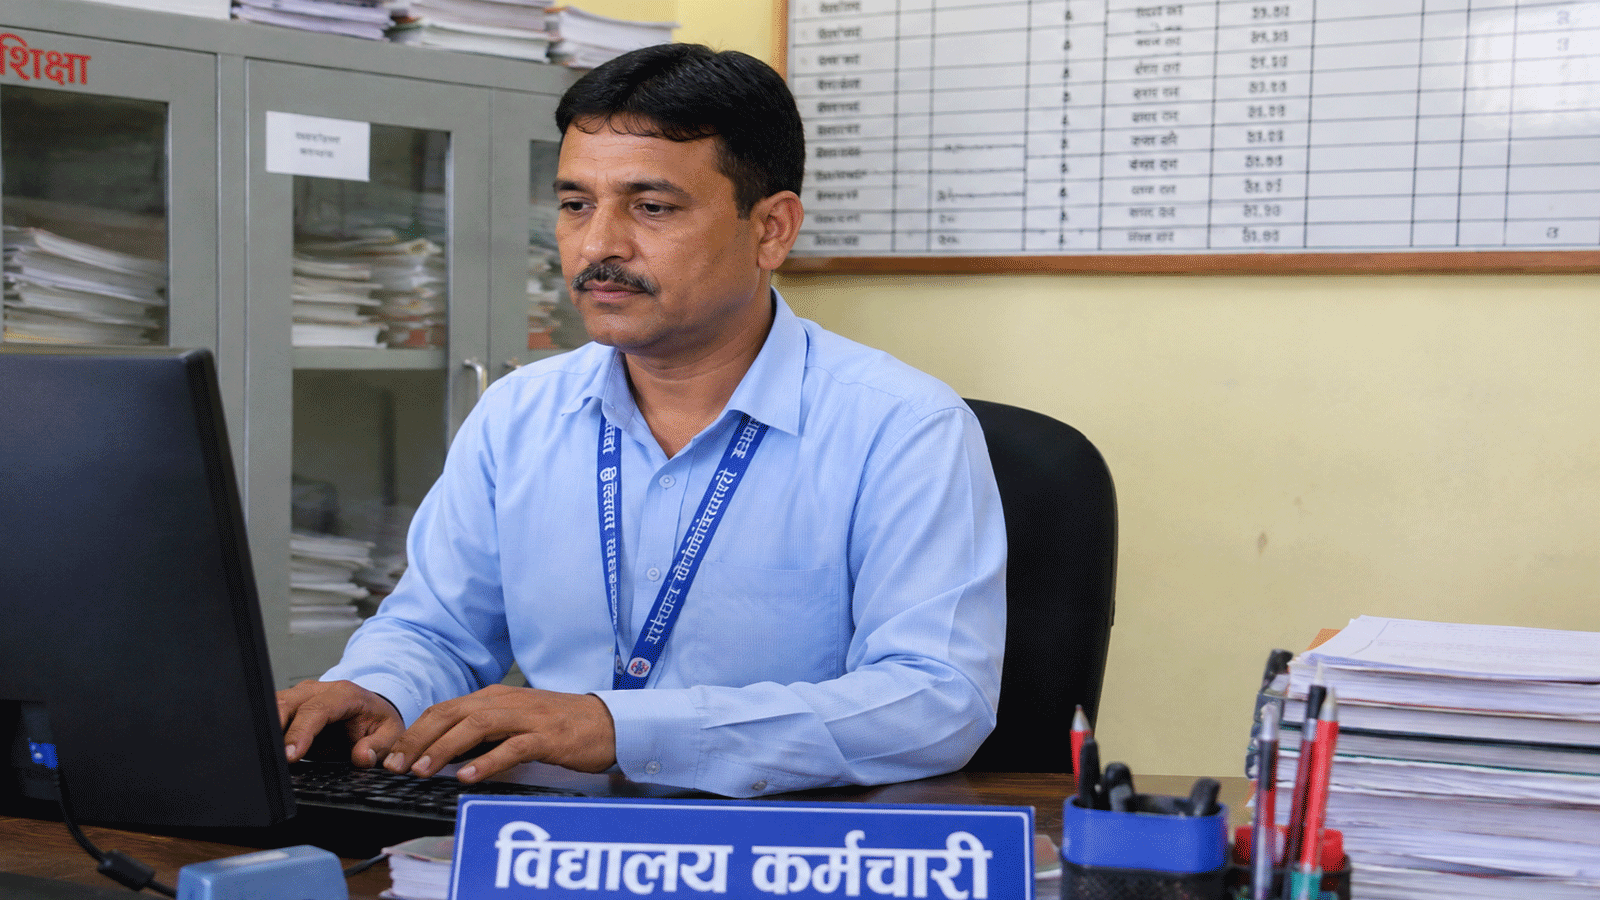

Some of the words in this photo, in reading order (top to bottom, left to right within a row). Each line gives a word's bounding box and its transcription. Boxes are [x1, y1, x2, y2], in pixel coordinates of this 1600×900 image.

[0, 32, 92, 86] शिक्षा
[495, 821, 734, 895] विद्यालय
[751, 829, 993, 900] कर्मचारी
